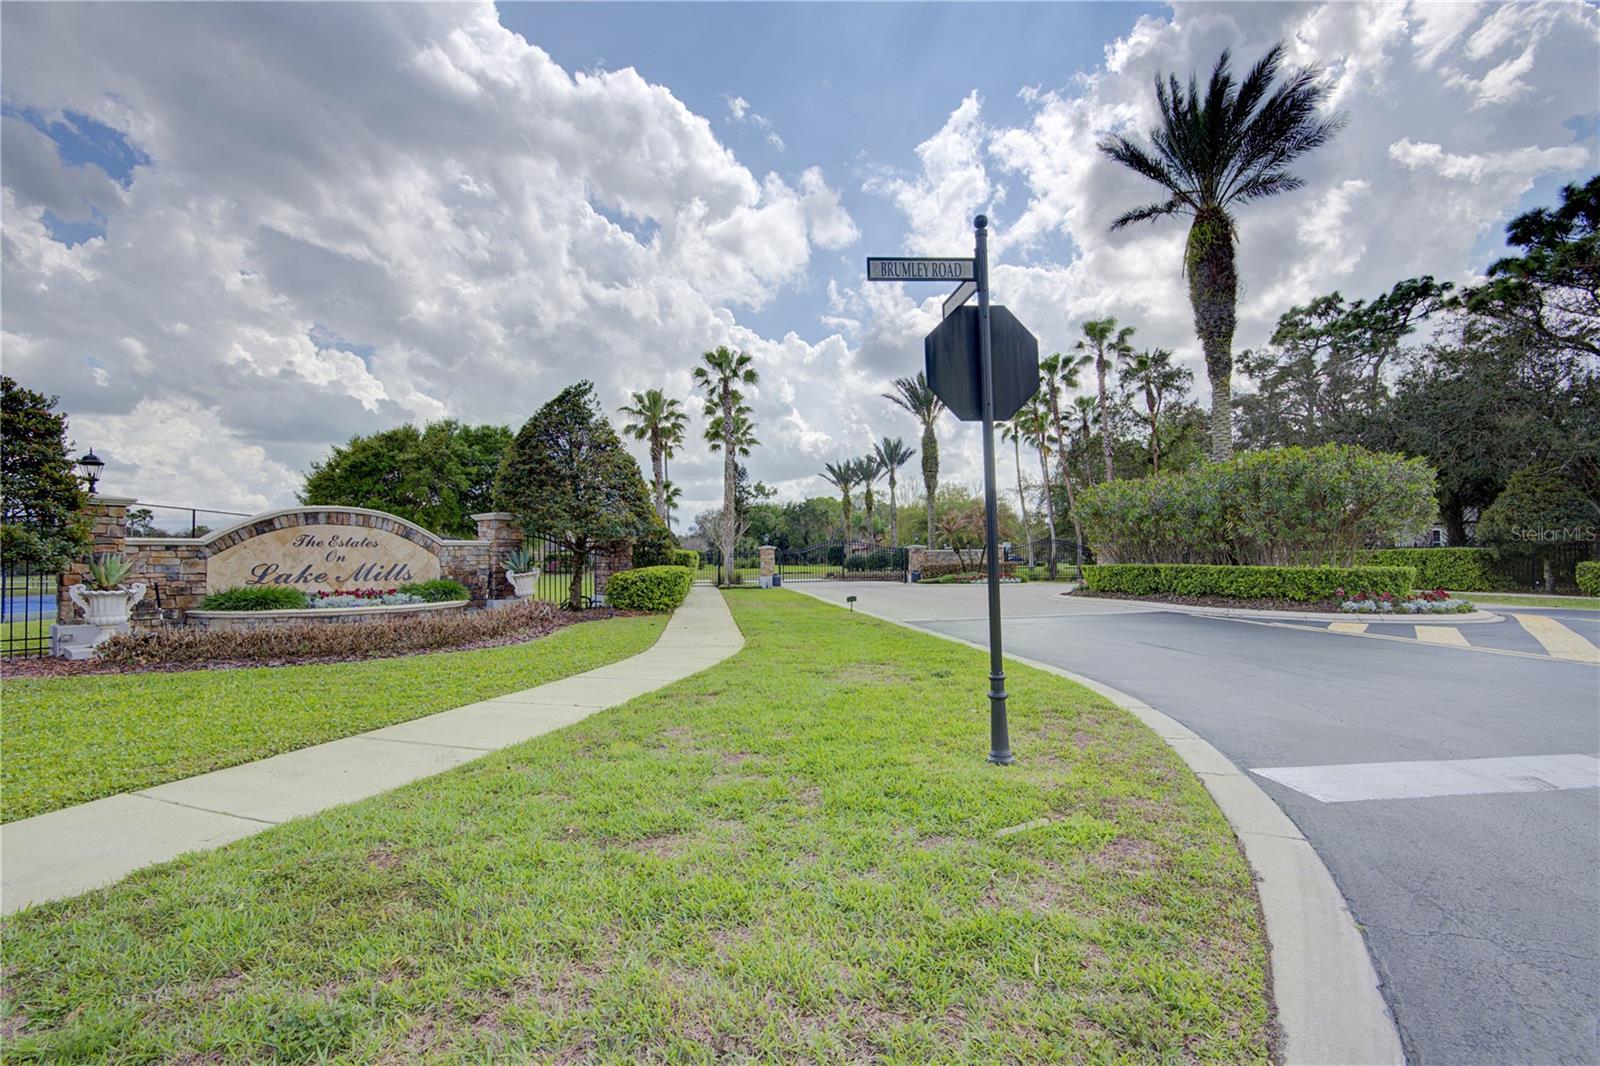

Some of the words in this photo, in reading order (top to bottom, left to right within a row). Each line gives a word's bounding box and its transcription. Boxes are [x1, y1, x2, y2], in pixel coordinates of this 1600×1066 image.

[880, 261, 928, 278] BRUMLEY
[931, 262, 962, 278] ROAD
[292, 534, 325, 548] The
[327, 535, 379, 548] Estates
[325, 550, 347, 563] On
[245, 563, 328, 585] Lake
[335, 562, 414, 584] Mills
